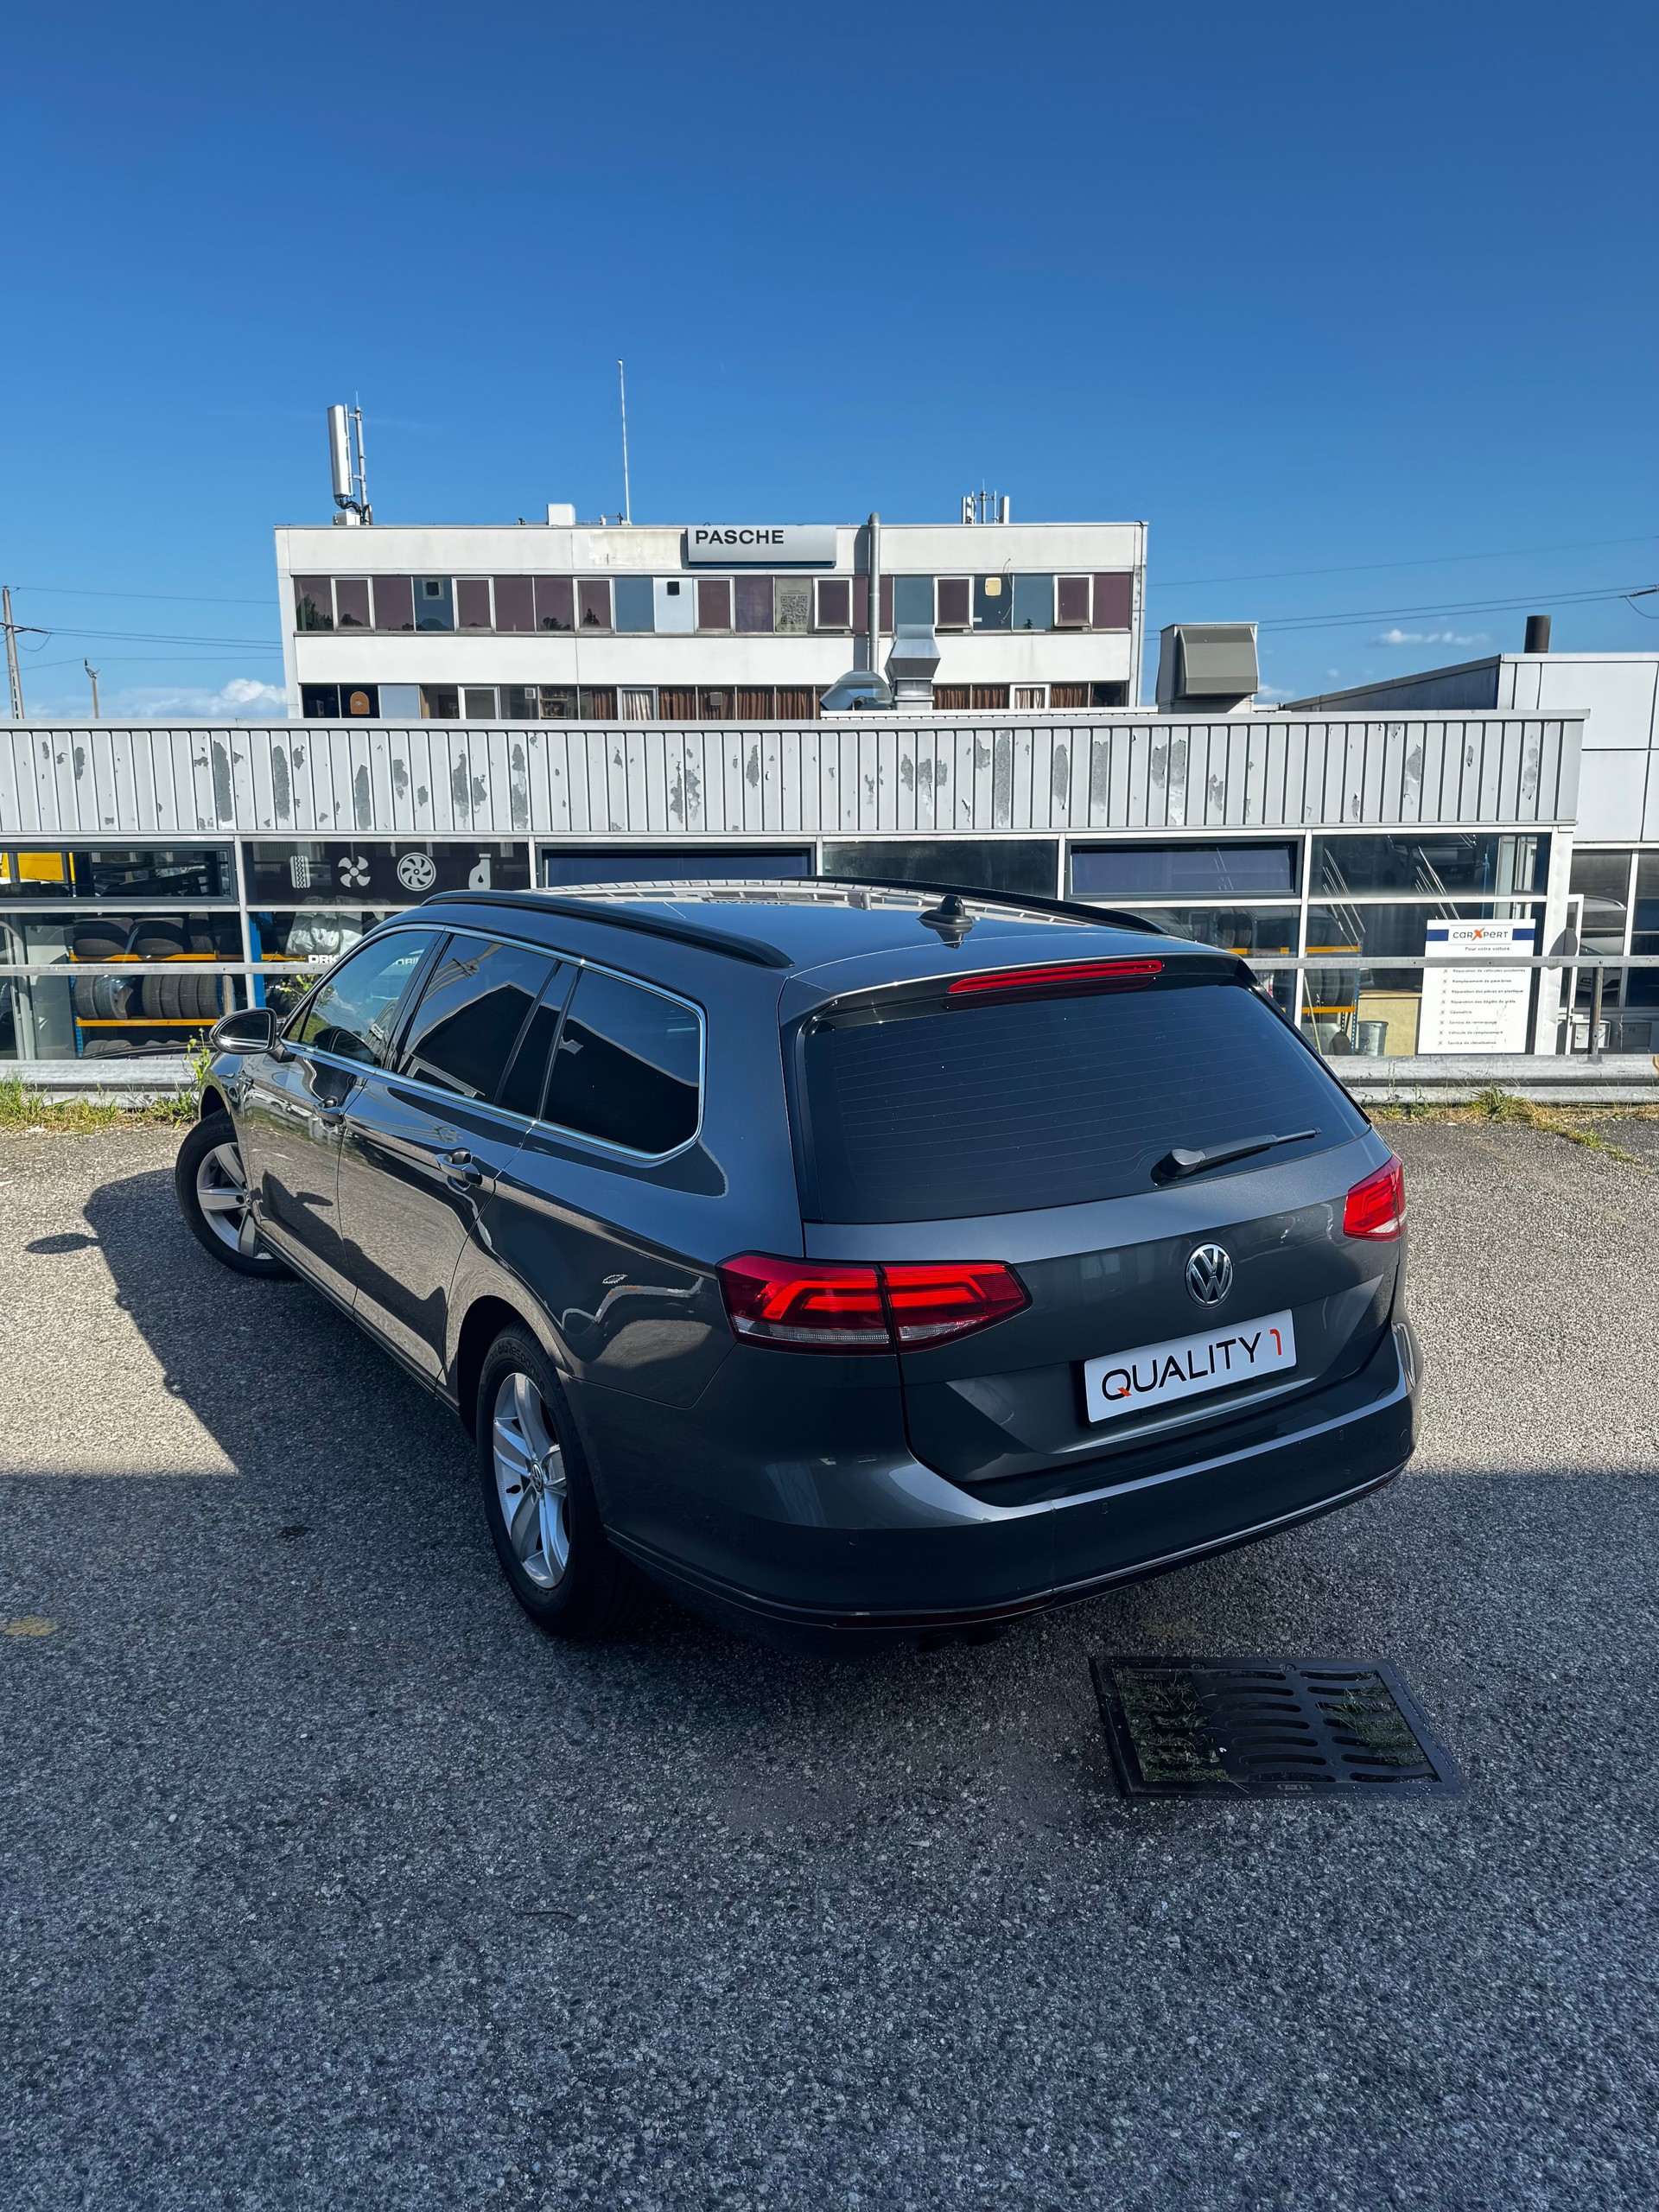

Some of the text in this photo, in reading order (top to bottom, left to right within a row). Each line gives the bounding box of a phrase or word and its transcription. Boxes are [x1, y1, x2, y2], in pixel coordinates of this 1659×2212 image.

[696, 530, 785, 544] PASCHE
[1102, 1328, 1282, 1401] QUALITY 1
